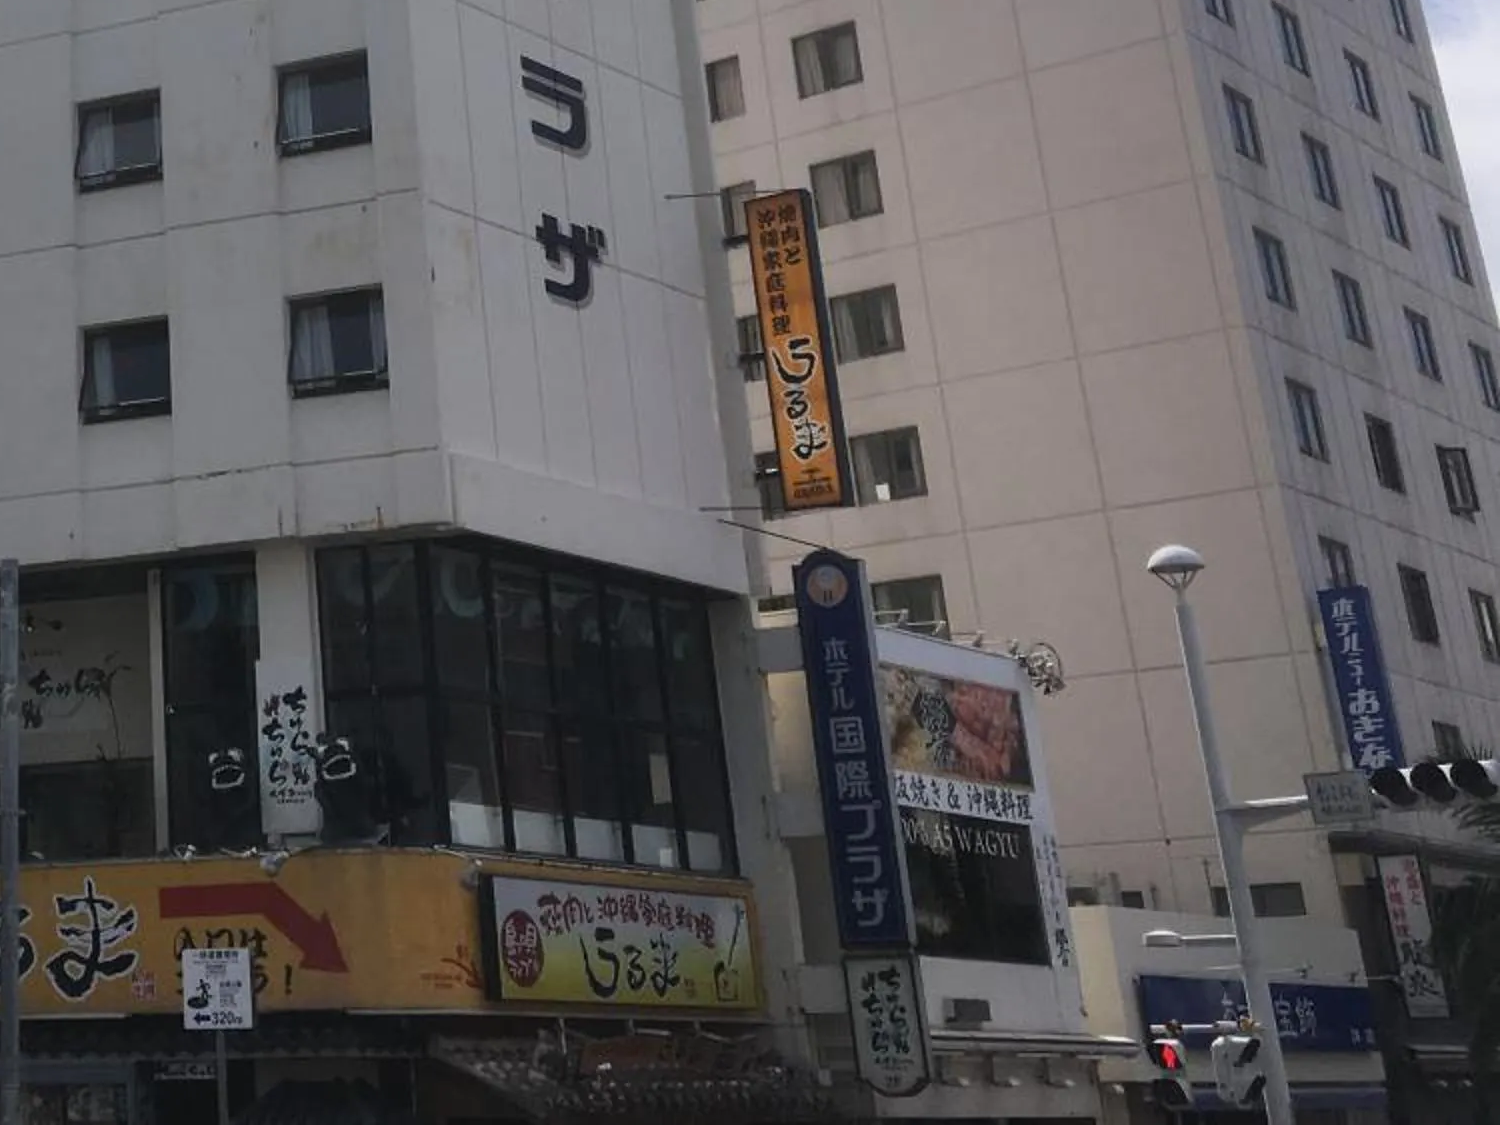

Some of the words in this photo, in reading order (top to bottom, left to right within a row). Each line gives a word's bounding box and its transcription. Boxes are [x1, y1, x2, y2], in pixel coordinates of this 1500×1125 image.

[822, 635, 890, 928] ホテル国際プラザ
[954, 825, 1020, 859] WAGYU
